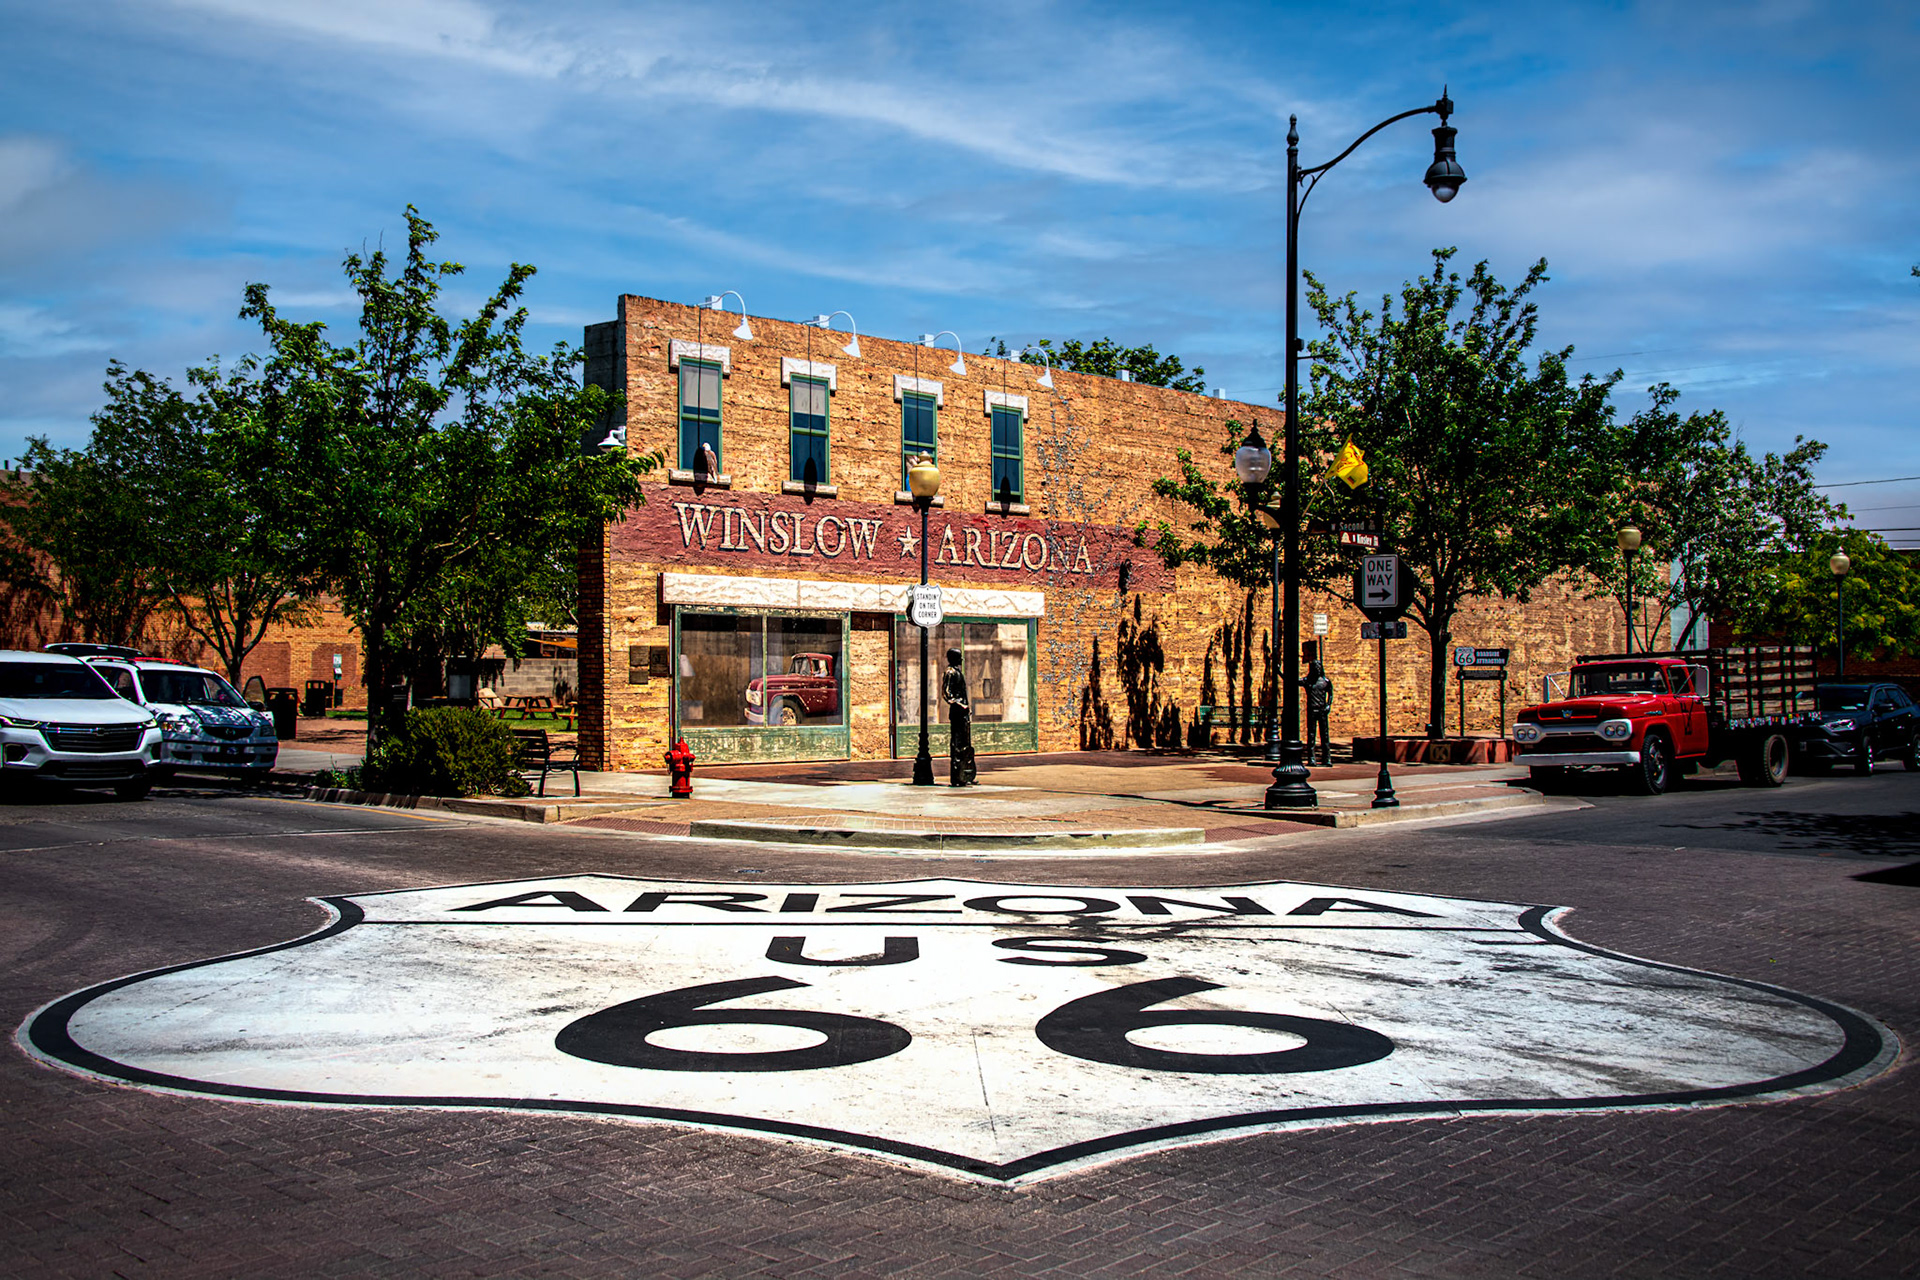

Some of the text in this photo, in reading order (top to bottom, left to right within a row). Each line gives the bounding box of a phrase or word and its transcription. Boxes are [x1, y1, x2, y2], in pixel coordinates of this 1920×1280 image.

[1339, 520, 1365, 531] Second
[672, 501, 1093, 575] WINSLOW ARIZONA
[1367, 560, 1393, 572] ONE
[1366, 574, 1393, 586] WAY
[1458, 653, 1473, 663] 66
[449, 891, 1442, 919] ARIZONA
[554, 976, 1396, 1074] 66
